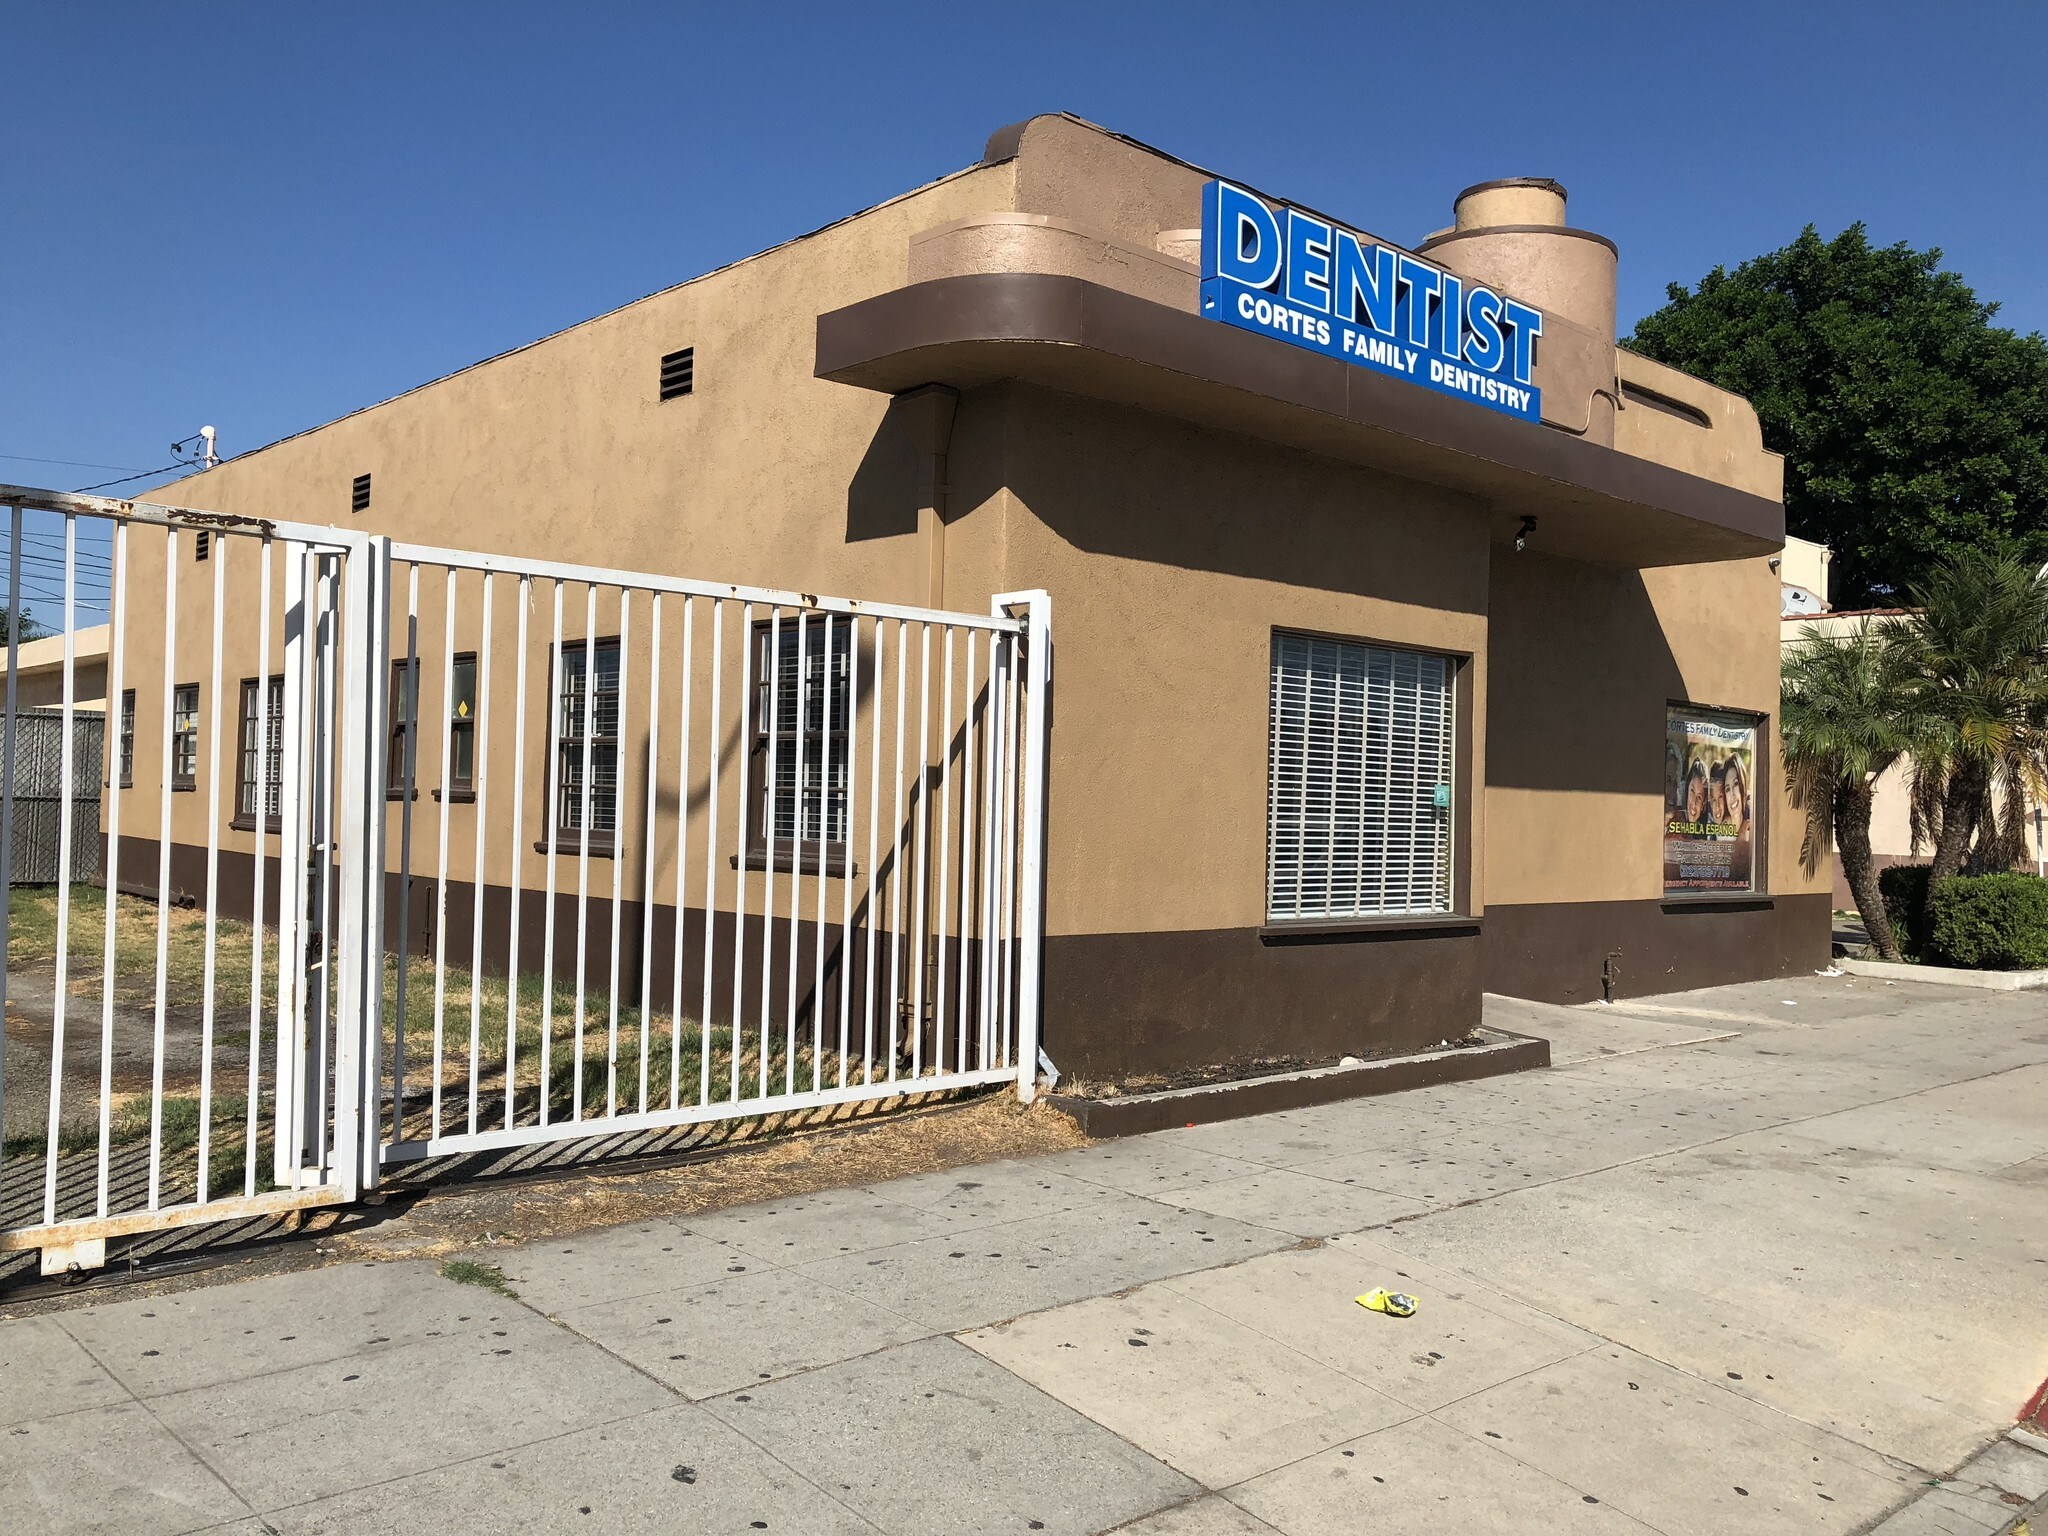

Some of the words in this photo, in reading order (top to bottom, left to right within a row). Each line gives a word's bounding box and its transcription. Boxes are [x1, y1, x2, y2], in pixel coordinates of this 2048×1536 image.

[1217, 179, 1543, 385] DENTIST
[1238, 293, 1331, 346] CORTES
[1343, 328, 1419, 374] FAMILY
[1430, 358, 1531, 412] DENTISTRY
[1667, 720, 1695, 734] CORTES
[1695, 724, 1717, 736] FAMILY
[1718, 728, 1749, 740] DENTISTRY
[1706, 821, 1738, 836] ESPAÑOL
